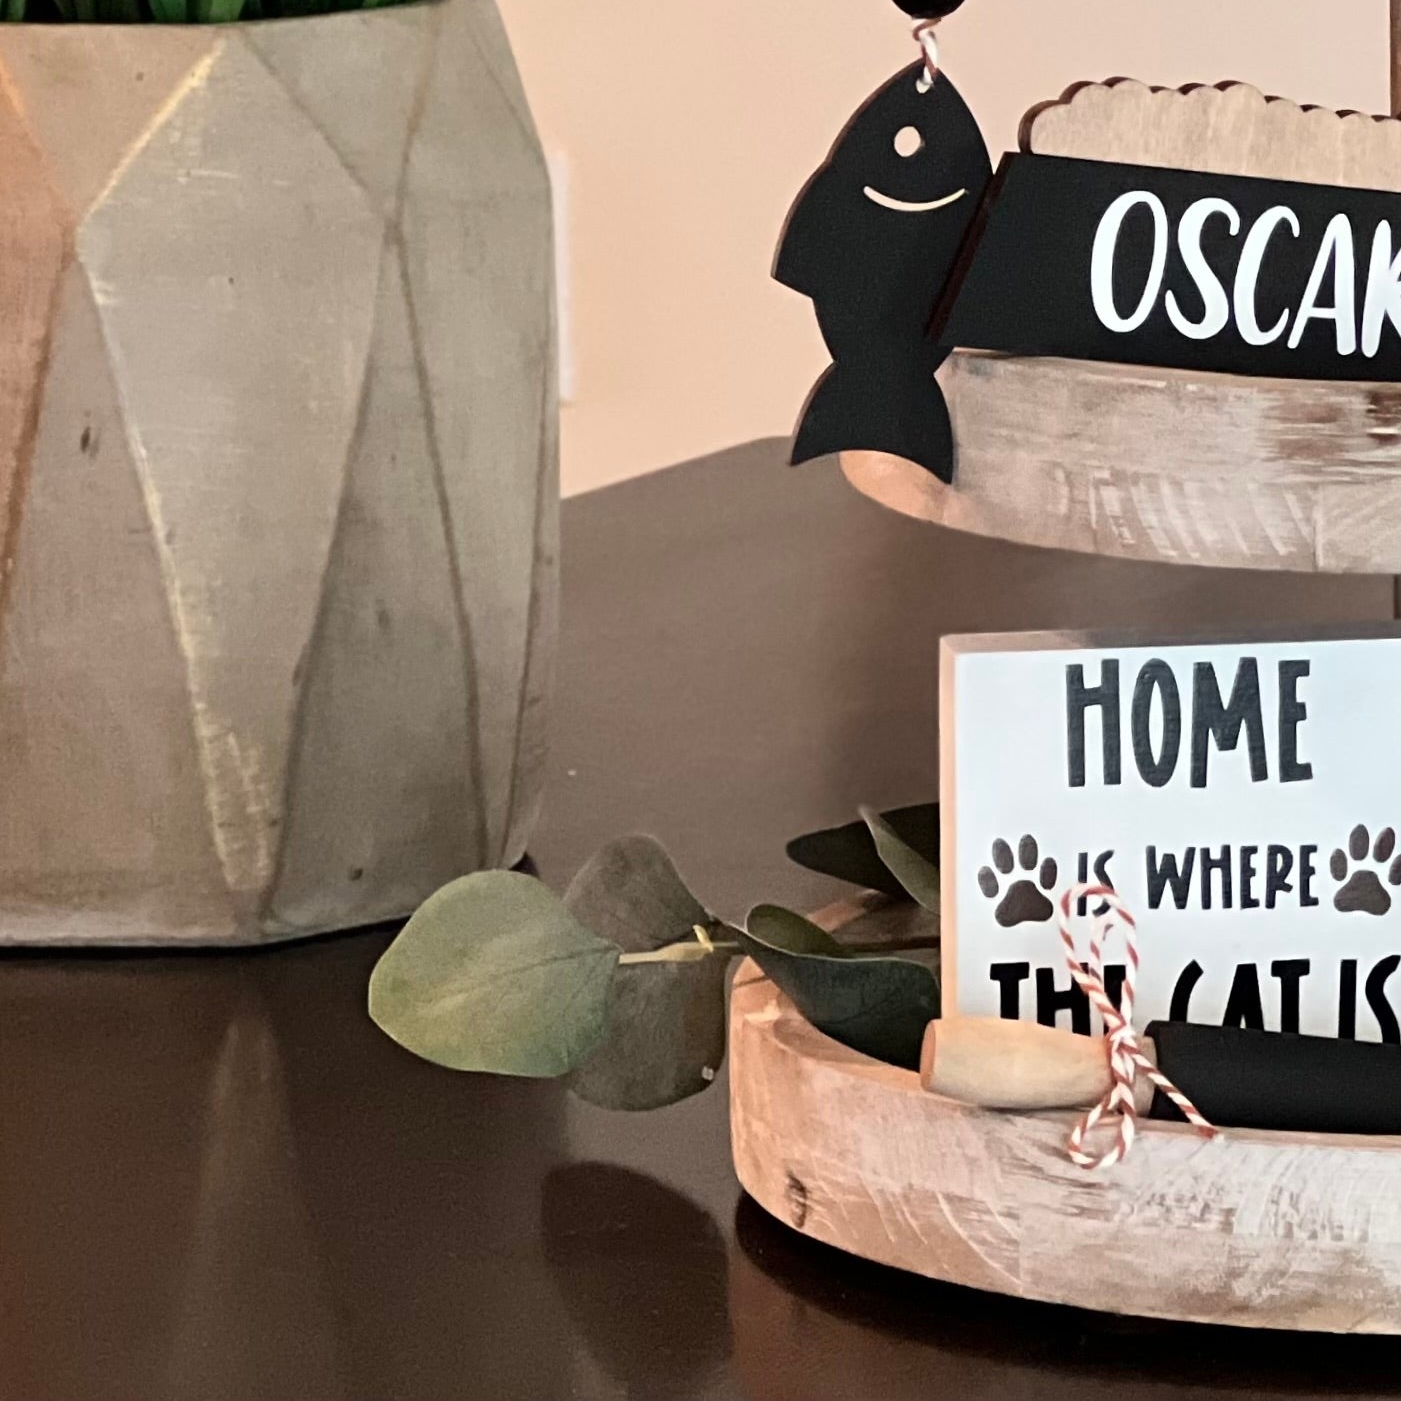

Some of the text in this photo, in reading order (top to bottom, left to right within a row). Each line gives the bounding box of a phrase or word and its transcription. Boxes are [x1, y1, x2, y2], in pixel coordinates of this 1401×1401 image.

[1065, 657, 1313, 788] HOME
[1077, 844, 1319, 916] IS WHERE
[1338, 954, 1401, 1045] IS
